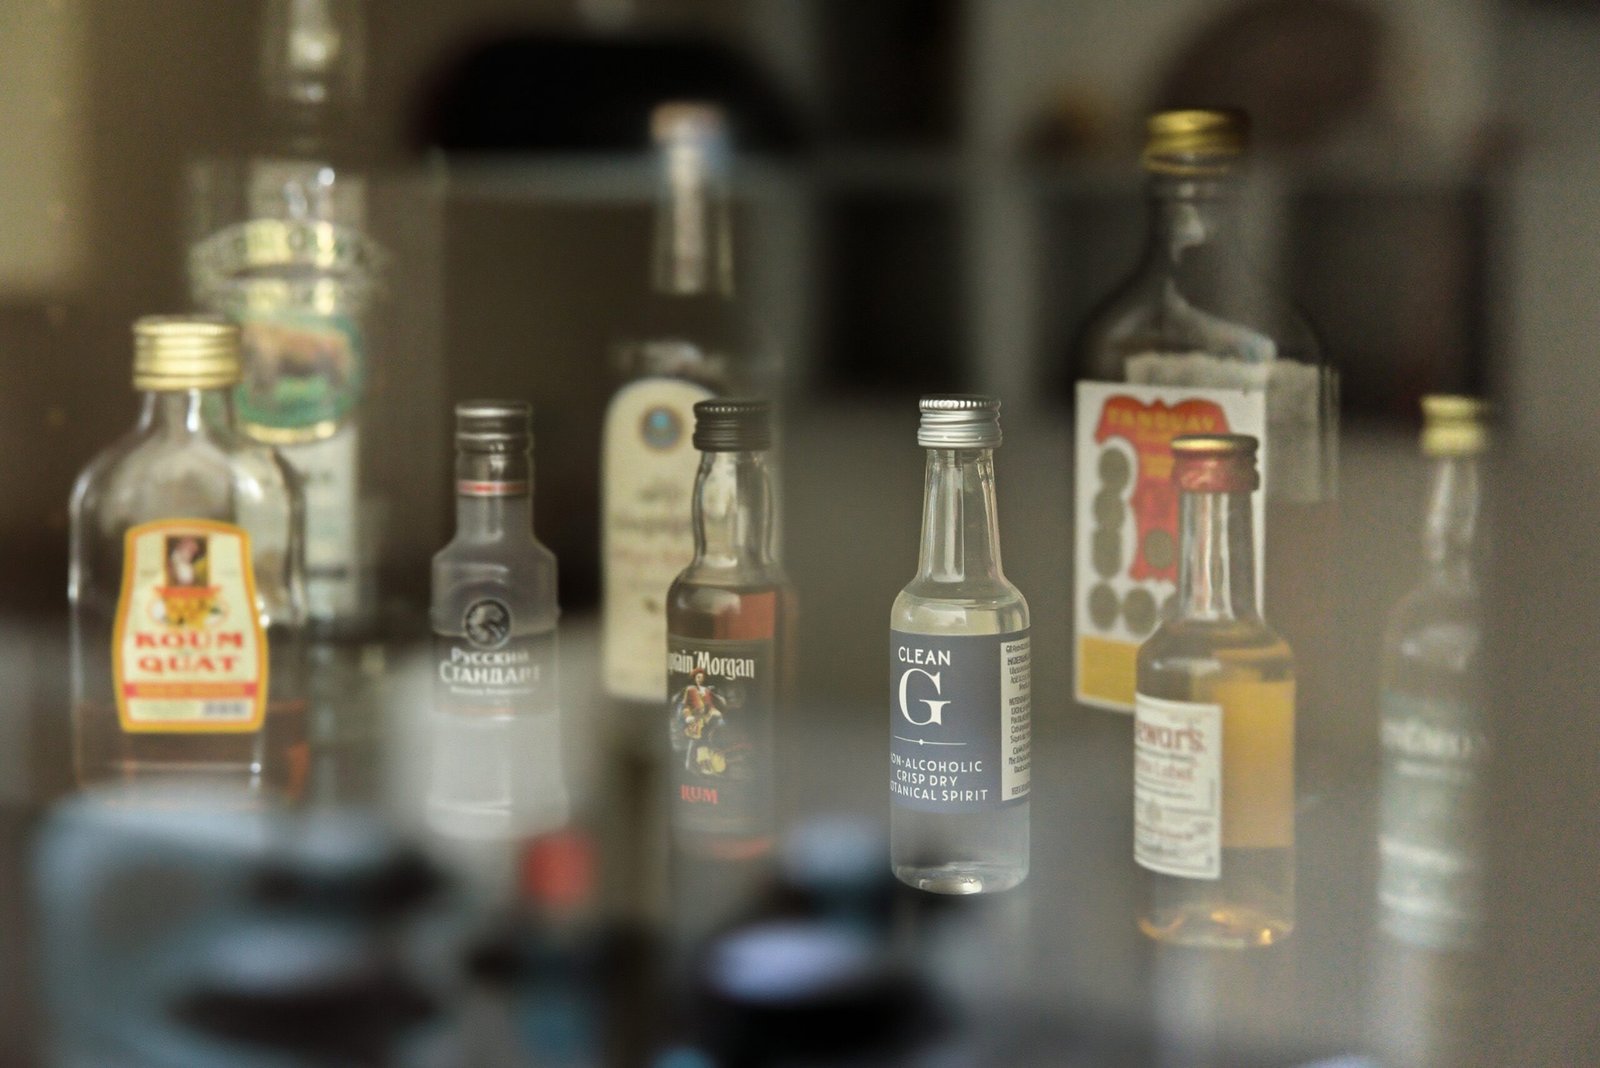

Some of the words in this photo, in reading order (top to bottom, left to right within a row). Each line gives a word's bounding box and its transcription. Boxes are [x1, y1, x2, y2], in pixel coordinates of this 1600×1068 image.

[135, 630, 244, 650] KOUM
[138, 655, 239, 674] QUAT
[694, 651, 755, 680] Morgan
[898, 646, 951, 666] CLEAN
[898, 668, 952, 726] G
[890, 752, 983, 772] ON-ALCOHOLIC
[896, 769, 925, 784] CRISP
[929, 775, 958, 786] DRY
[680, 784, 719, 804] RUM
[890, 780, 937, 800] OTANICAL
[942, 789, 988, 801] SPIRIT
